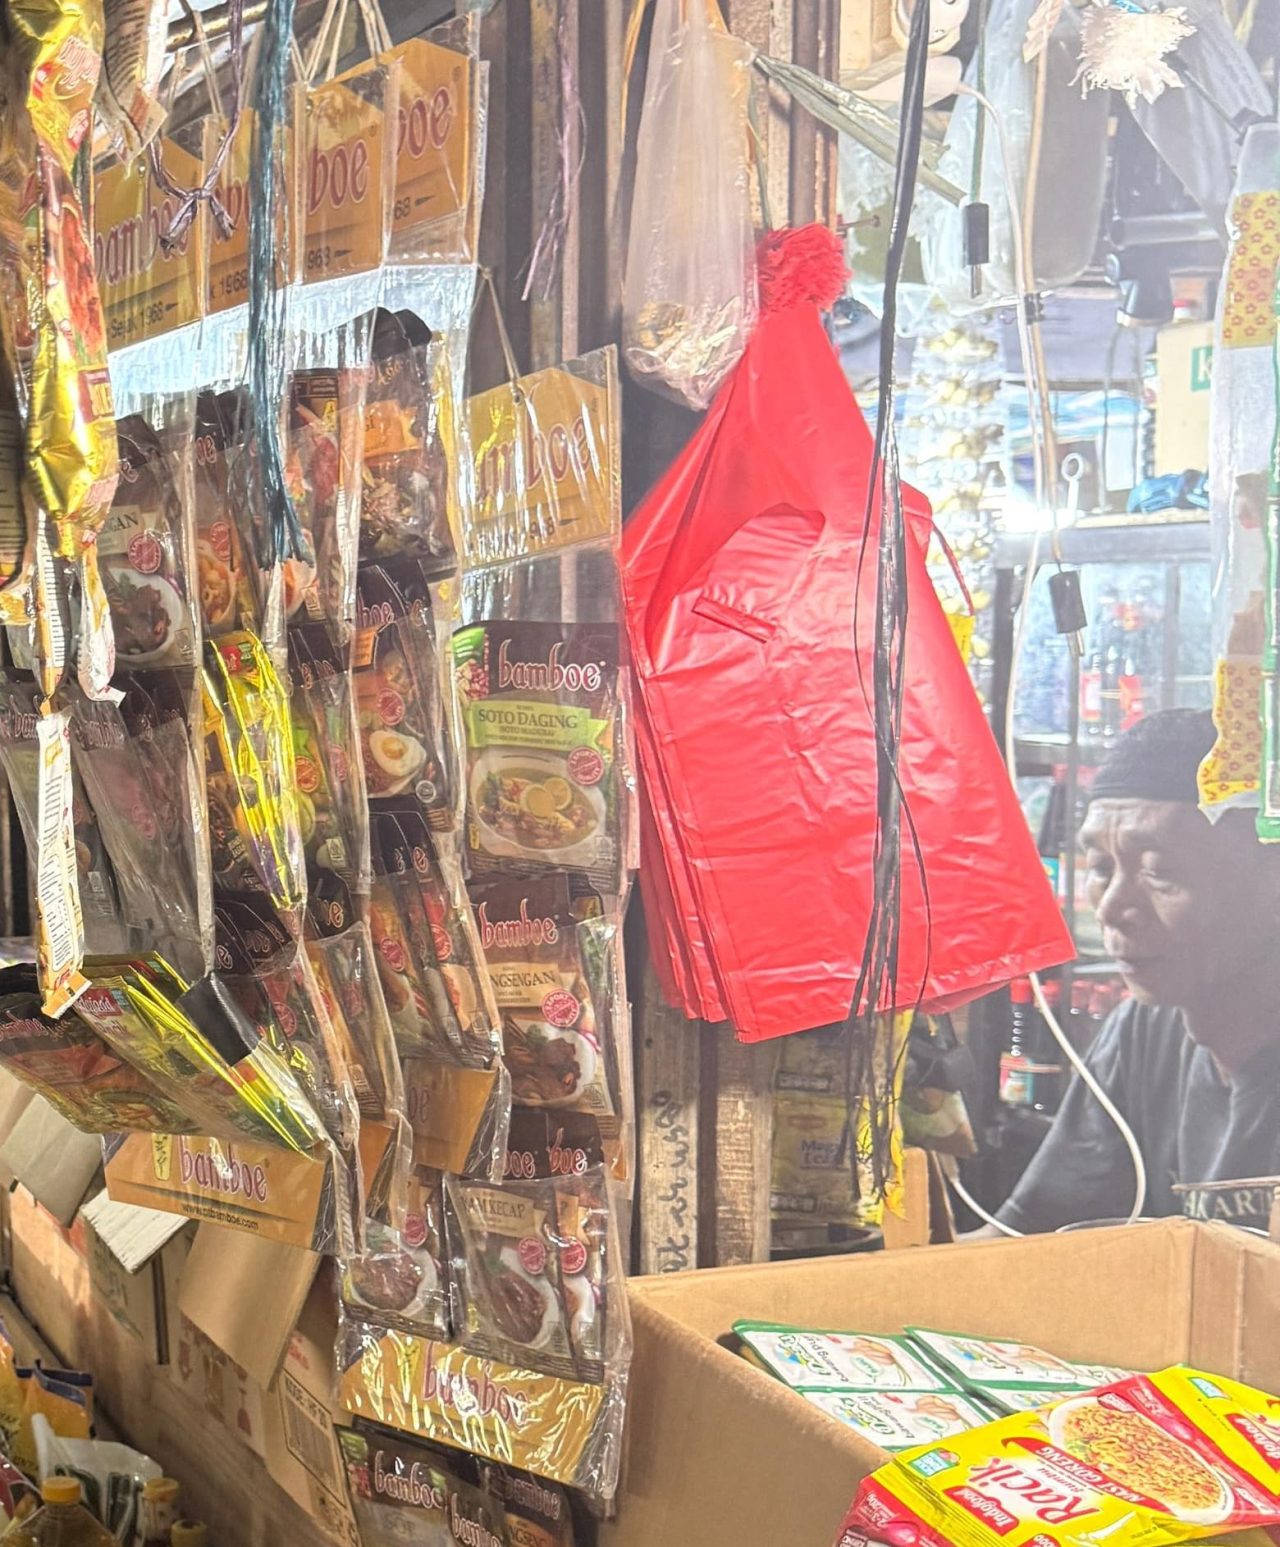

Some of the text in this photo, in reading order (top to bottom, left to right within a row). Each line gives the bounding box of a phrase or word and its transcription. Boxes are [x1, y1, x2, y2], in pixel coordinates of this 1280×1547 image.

[499, 638, 602, 691] bamboe
[478, 708, 578, 729] SOTO DAGING
[479, 898, 559, 949] bamboe
[489, 970, 556, 988] NGSENGAN
[970, 1456, 1100, 1526] Racik
[1037, 1445, 1144, 1503] NASI GORENG
[952, 1486, 1015, 1529] Indofood
